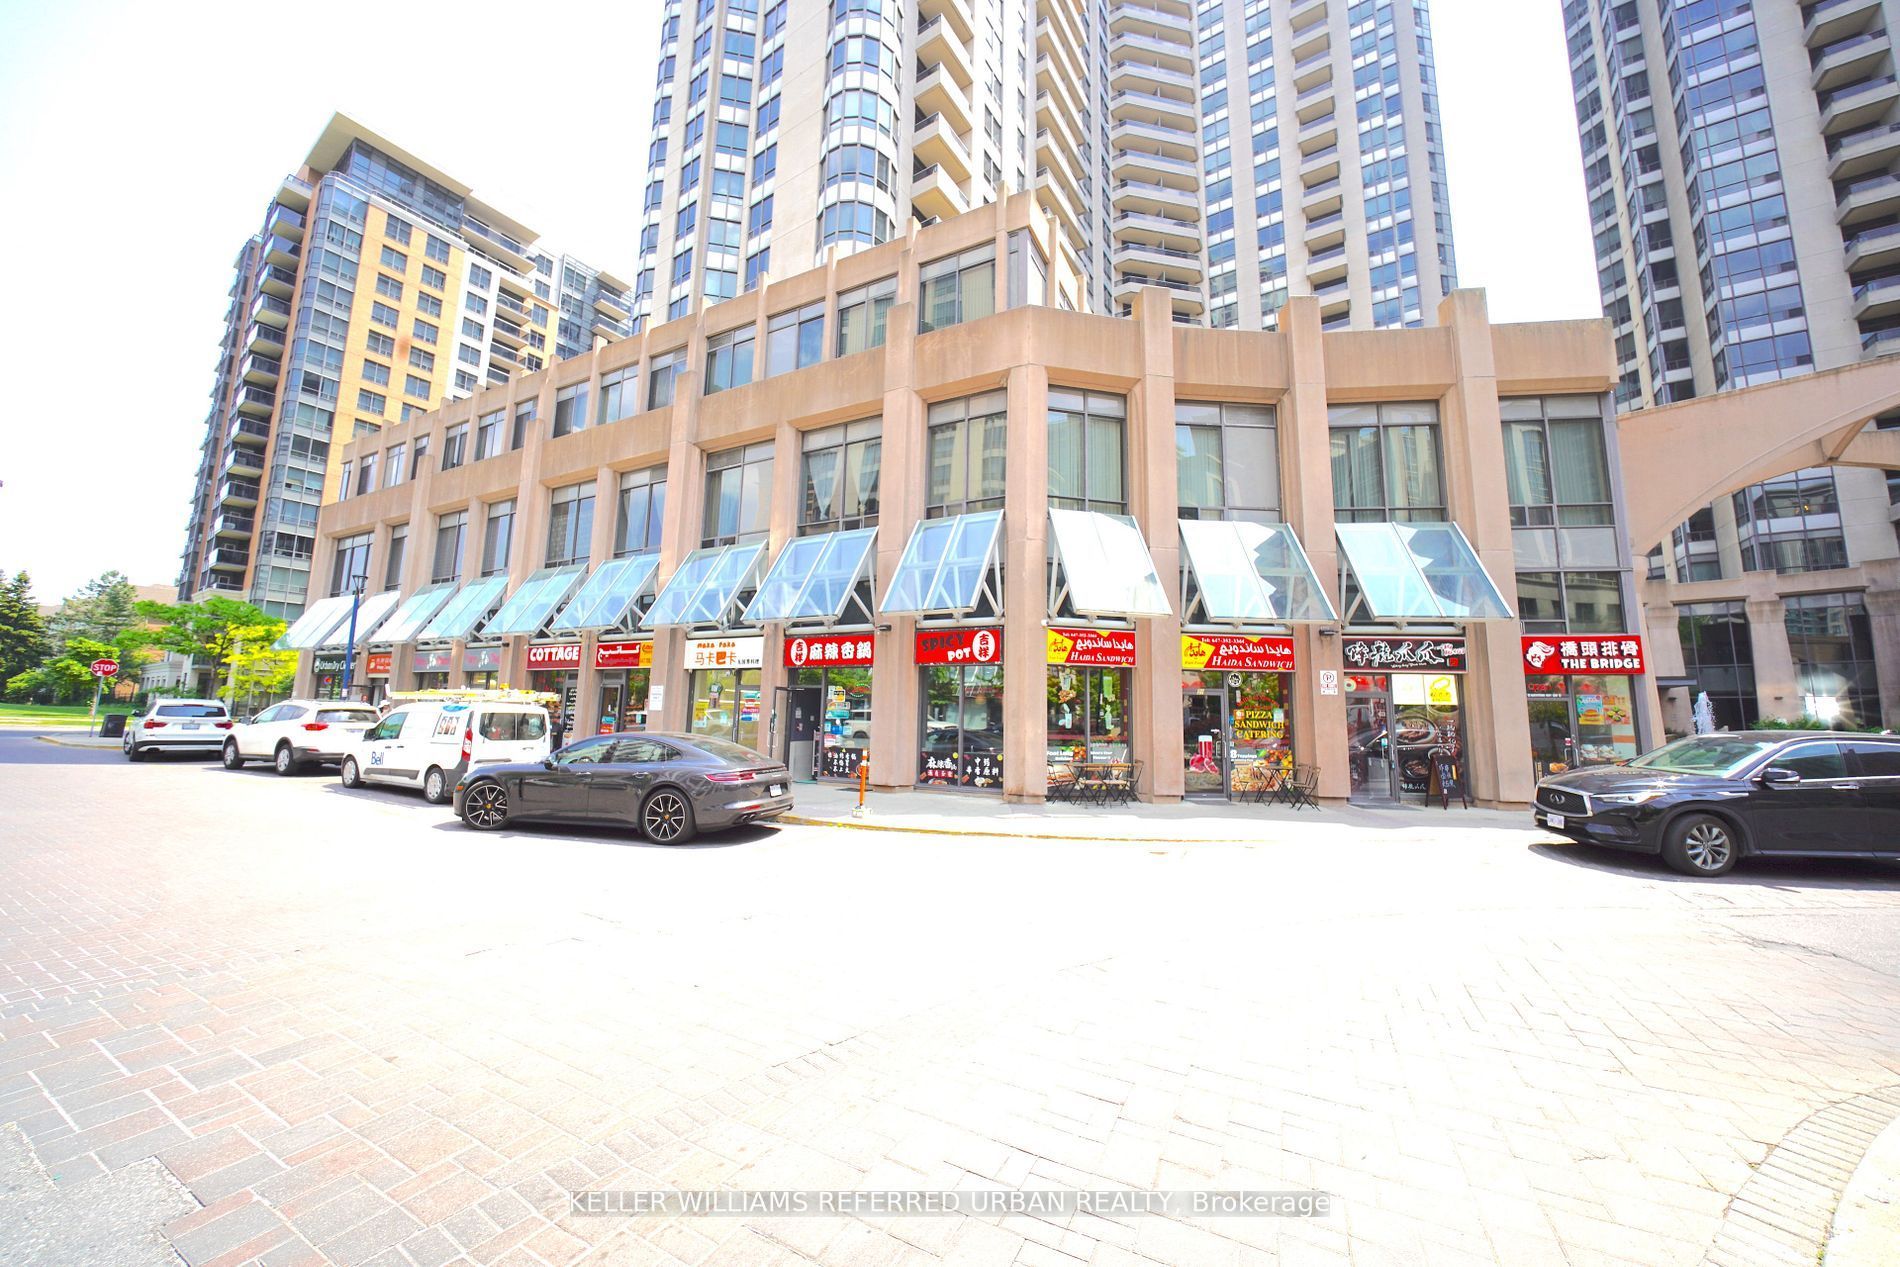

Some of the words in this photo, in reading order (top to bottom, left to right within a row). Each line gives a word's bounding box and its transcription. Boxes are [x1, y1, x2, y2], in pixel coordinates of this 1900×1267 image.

[922, 634, 965, 652] SPICY
[1560, 640, 1639, 657] 橋頭排骨
[529, 646, 580, 662] COTTAGE
[695, 651, 737, 665] 马卡巴卡
[947, 647, 971, 661] POT
[1070, 651, 1095, 661] HAIDA
[1096, 652, 1134, 663] SANDWICH
[93, 663, 117, 671] STOP
[1211, 656, 1243, 666] HAIDA
[1244, 656, 1293, 669] SANDWICH
[1561, 658, 1587, 669] THE
[1590, 658, 1641, 669] BRIDGE
[1245, 710, 1273, 719] PIZZA
[1234, 720, 1285, 729] SANDWICH
[1235, 730, 1285, 739] CATERING
[370, 751, 385, 766] Bell
